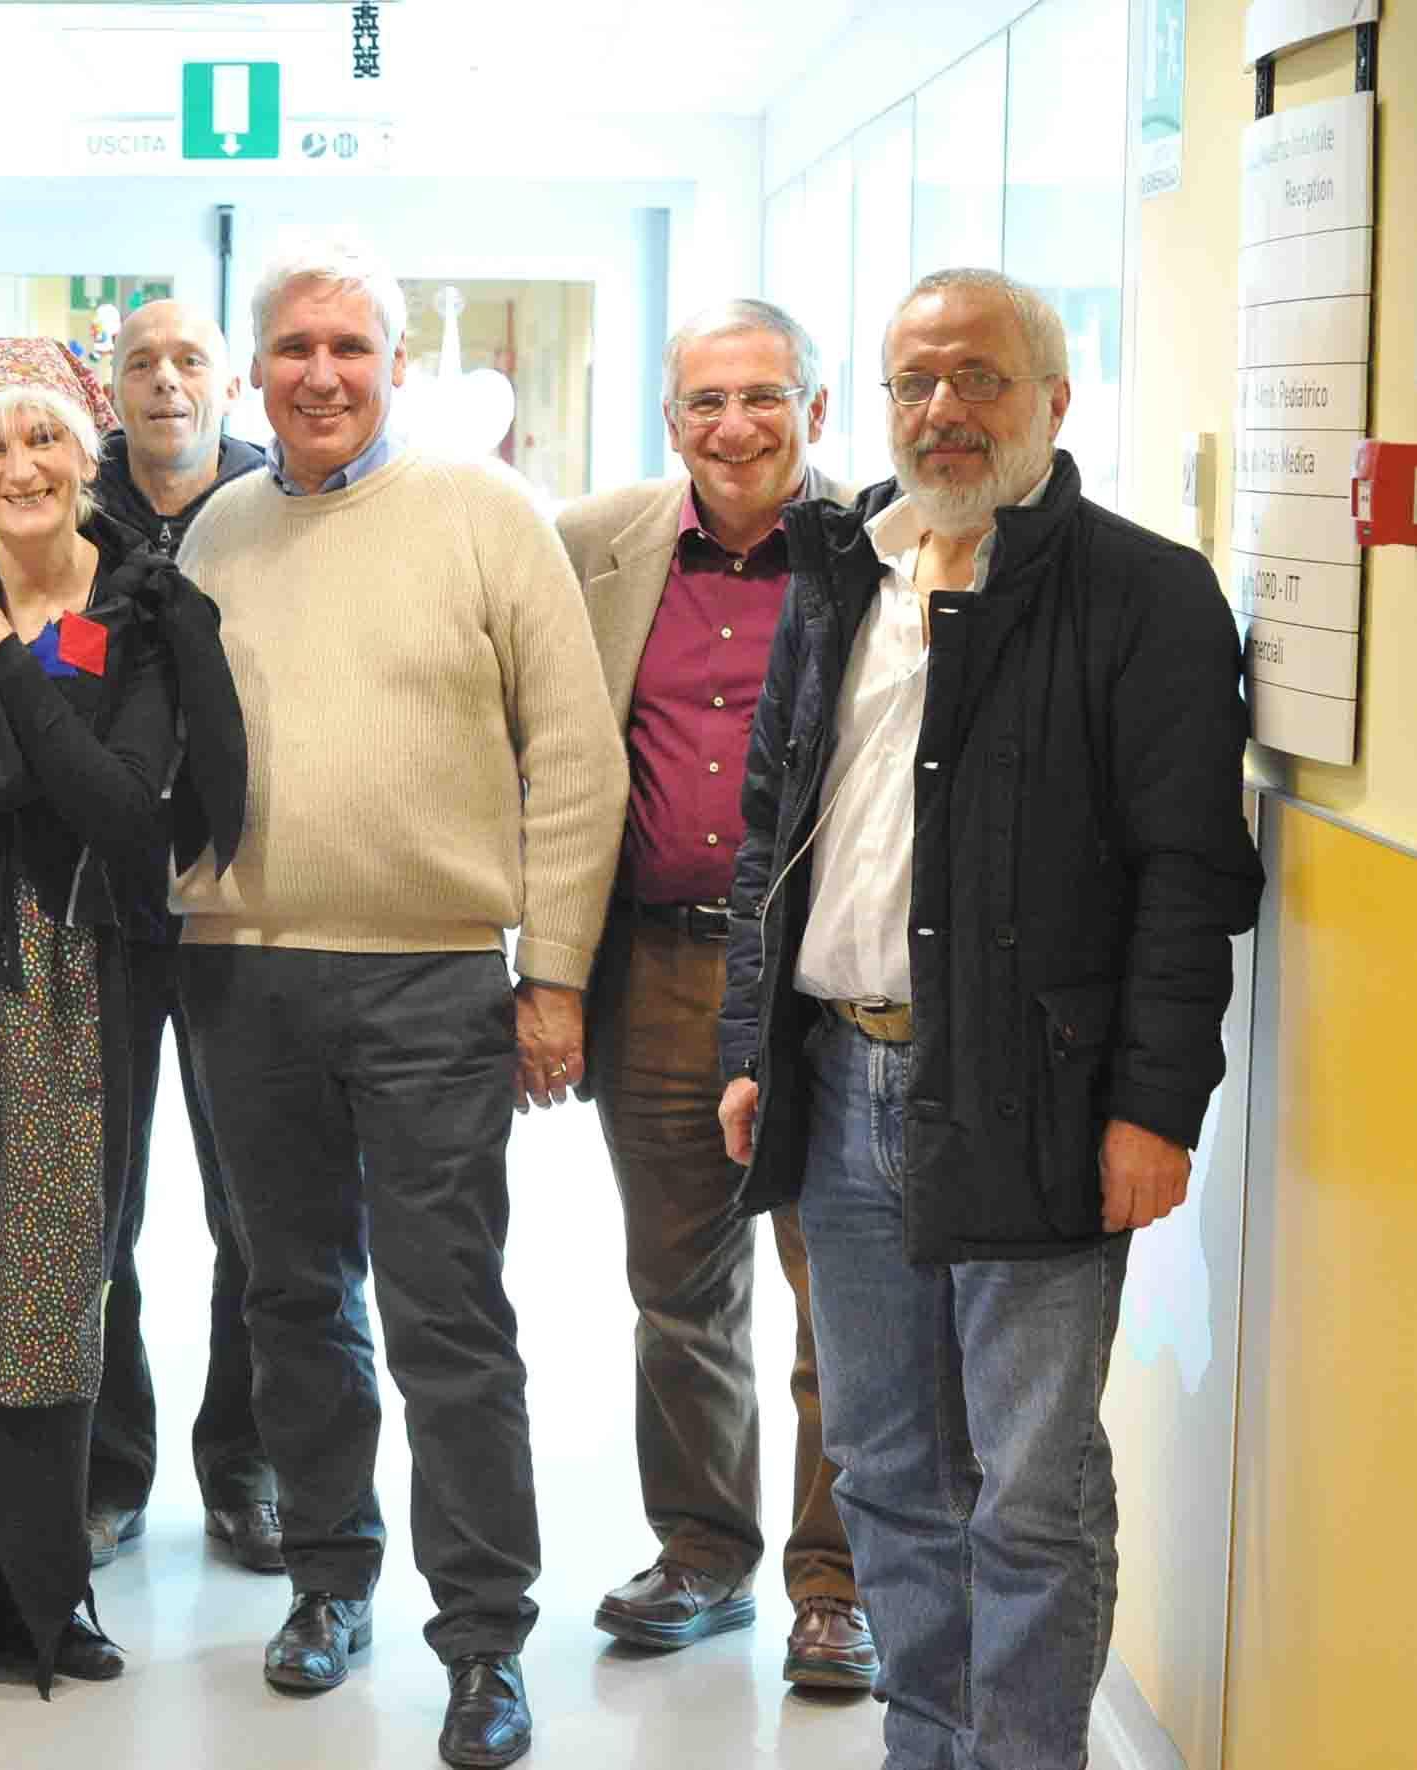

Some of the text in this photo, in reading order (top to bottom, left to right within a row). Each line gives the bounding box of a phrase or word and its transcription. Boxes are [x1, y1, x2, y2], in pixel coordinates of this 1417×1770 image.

[86, 135, 166, 155] USCITA
[1285, 177, 1333, 212] Reception
[1279, 379, 1329, 408] Pediatrico
[1281, 445, 1316, 474] Medica
